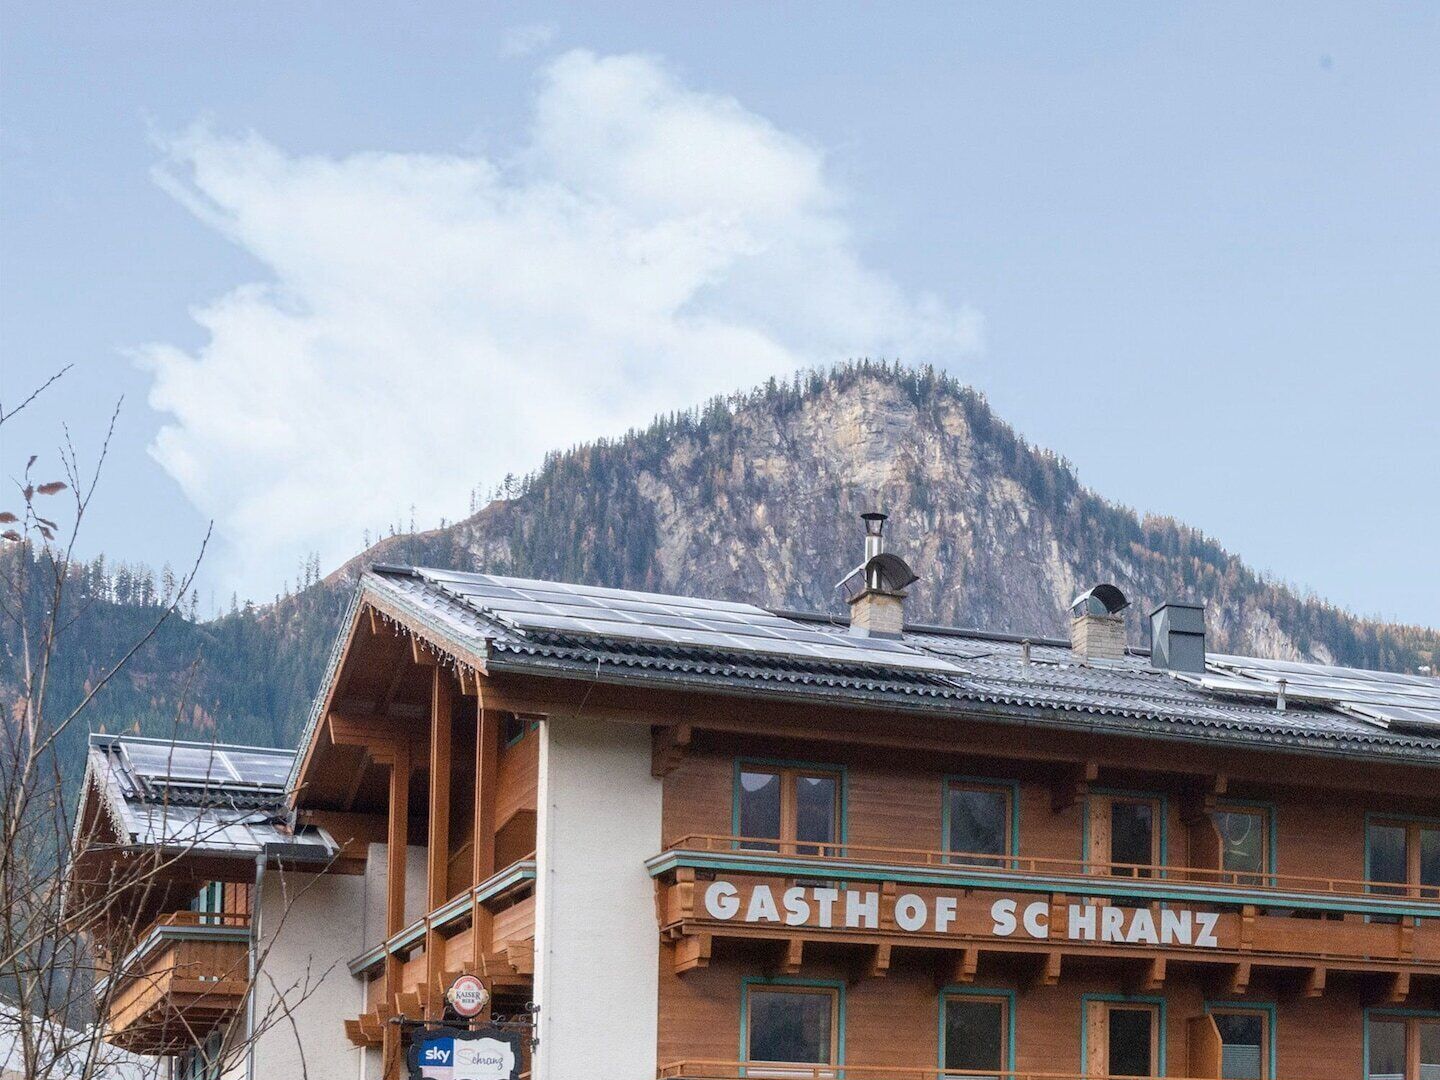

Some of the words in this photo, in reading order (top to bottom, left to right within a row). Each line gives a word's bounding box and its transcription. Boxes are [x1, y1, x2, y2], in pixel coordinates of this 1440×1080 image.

[705, 881, 957, 932] GASTHOF
[991, 899, 1219, 947] SCHRANZ
[456, 991, 481, 1001] KAISER
[425, 1046, 451, 1064] sky
[456, 1048, 503, 1070] Schranz
